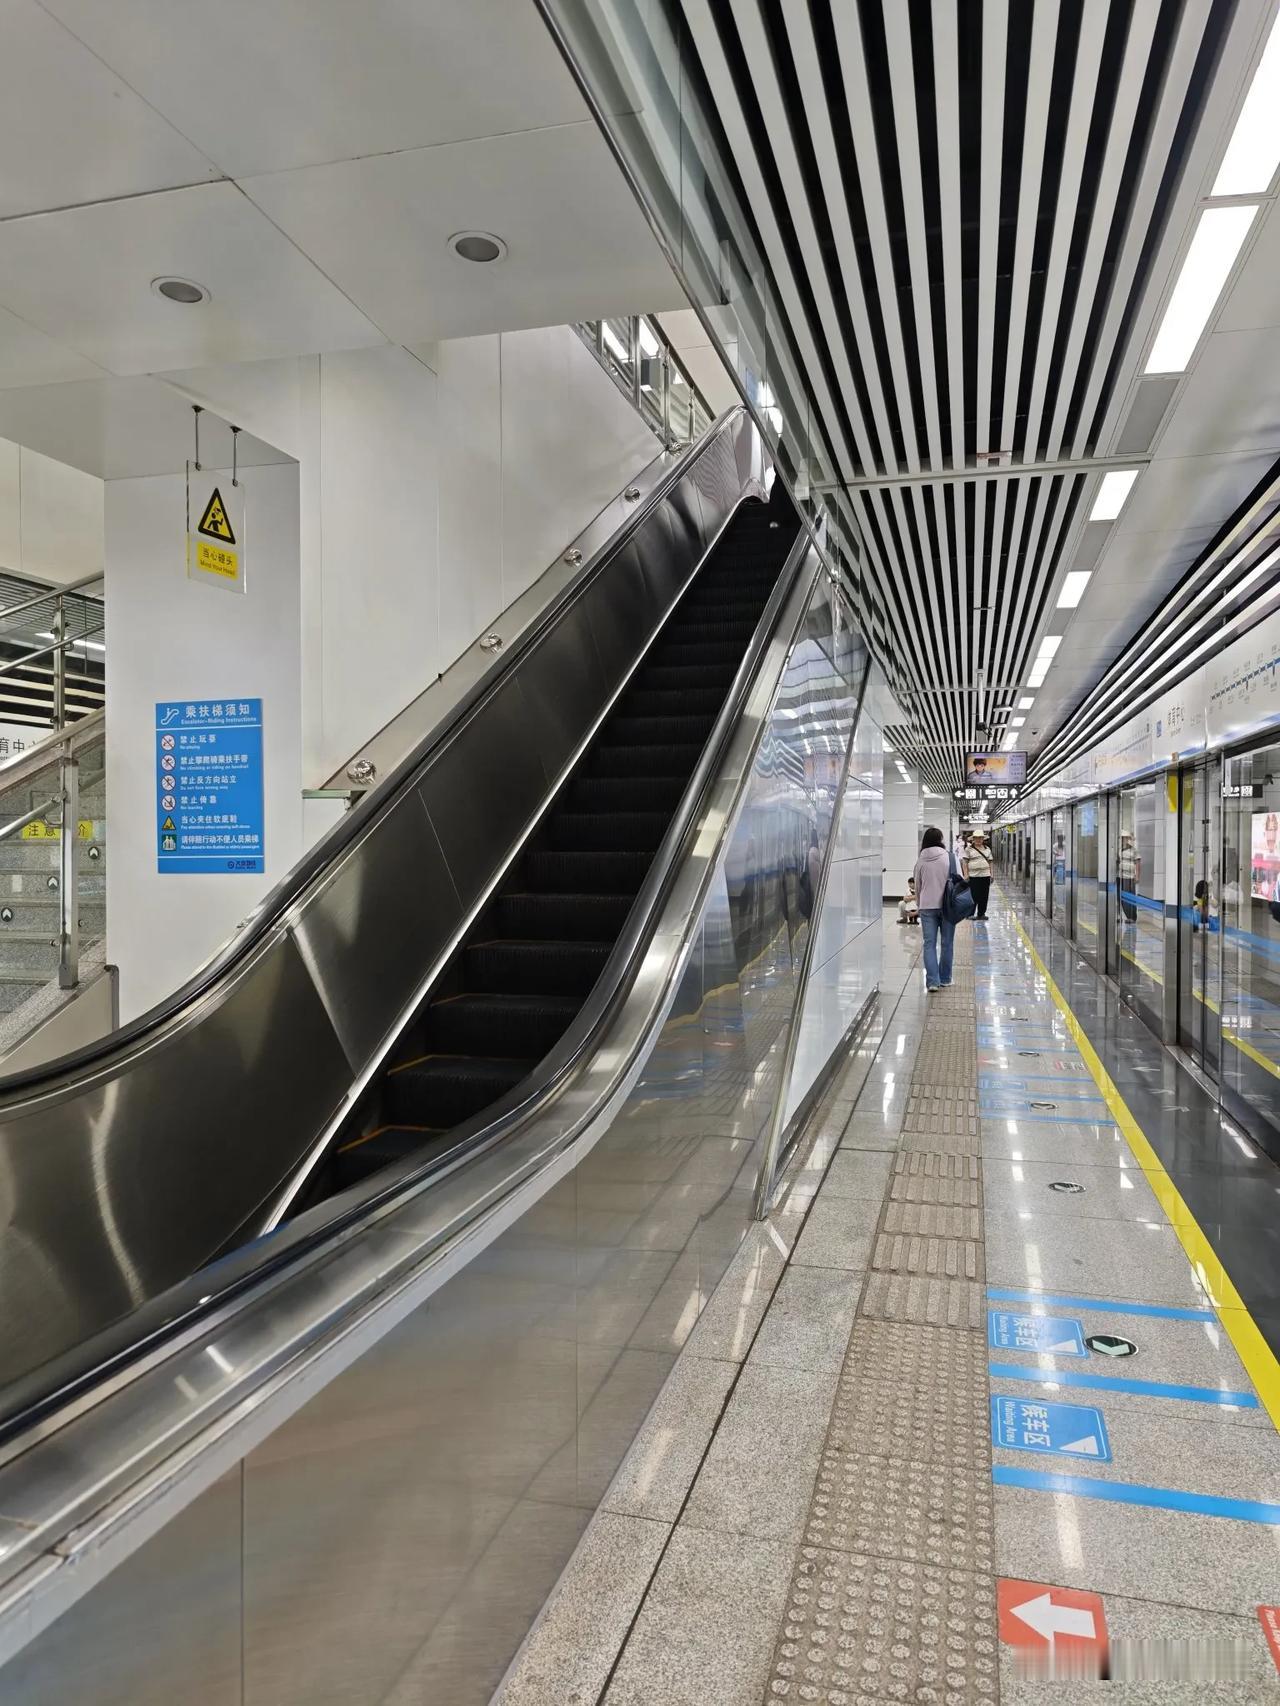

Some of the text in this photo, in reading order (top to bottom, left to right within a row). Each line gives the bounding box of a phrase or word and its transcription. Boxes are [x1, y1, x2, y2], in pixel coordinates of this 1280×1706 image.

[203, 547, 233, 567] 当心碰头
[186, 704, 250, 718] 乘扶梯须知
[181, 776, 236, 784] 禁止反方向站立
[1003, 1401, 1017, 1443] Waiting Area
[1020, 1403, 1051, 1447] 候车区
